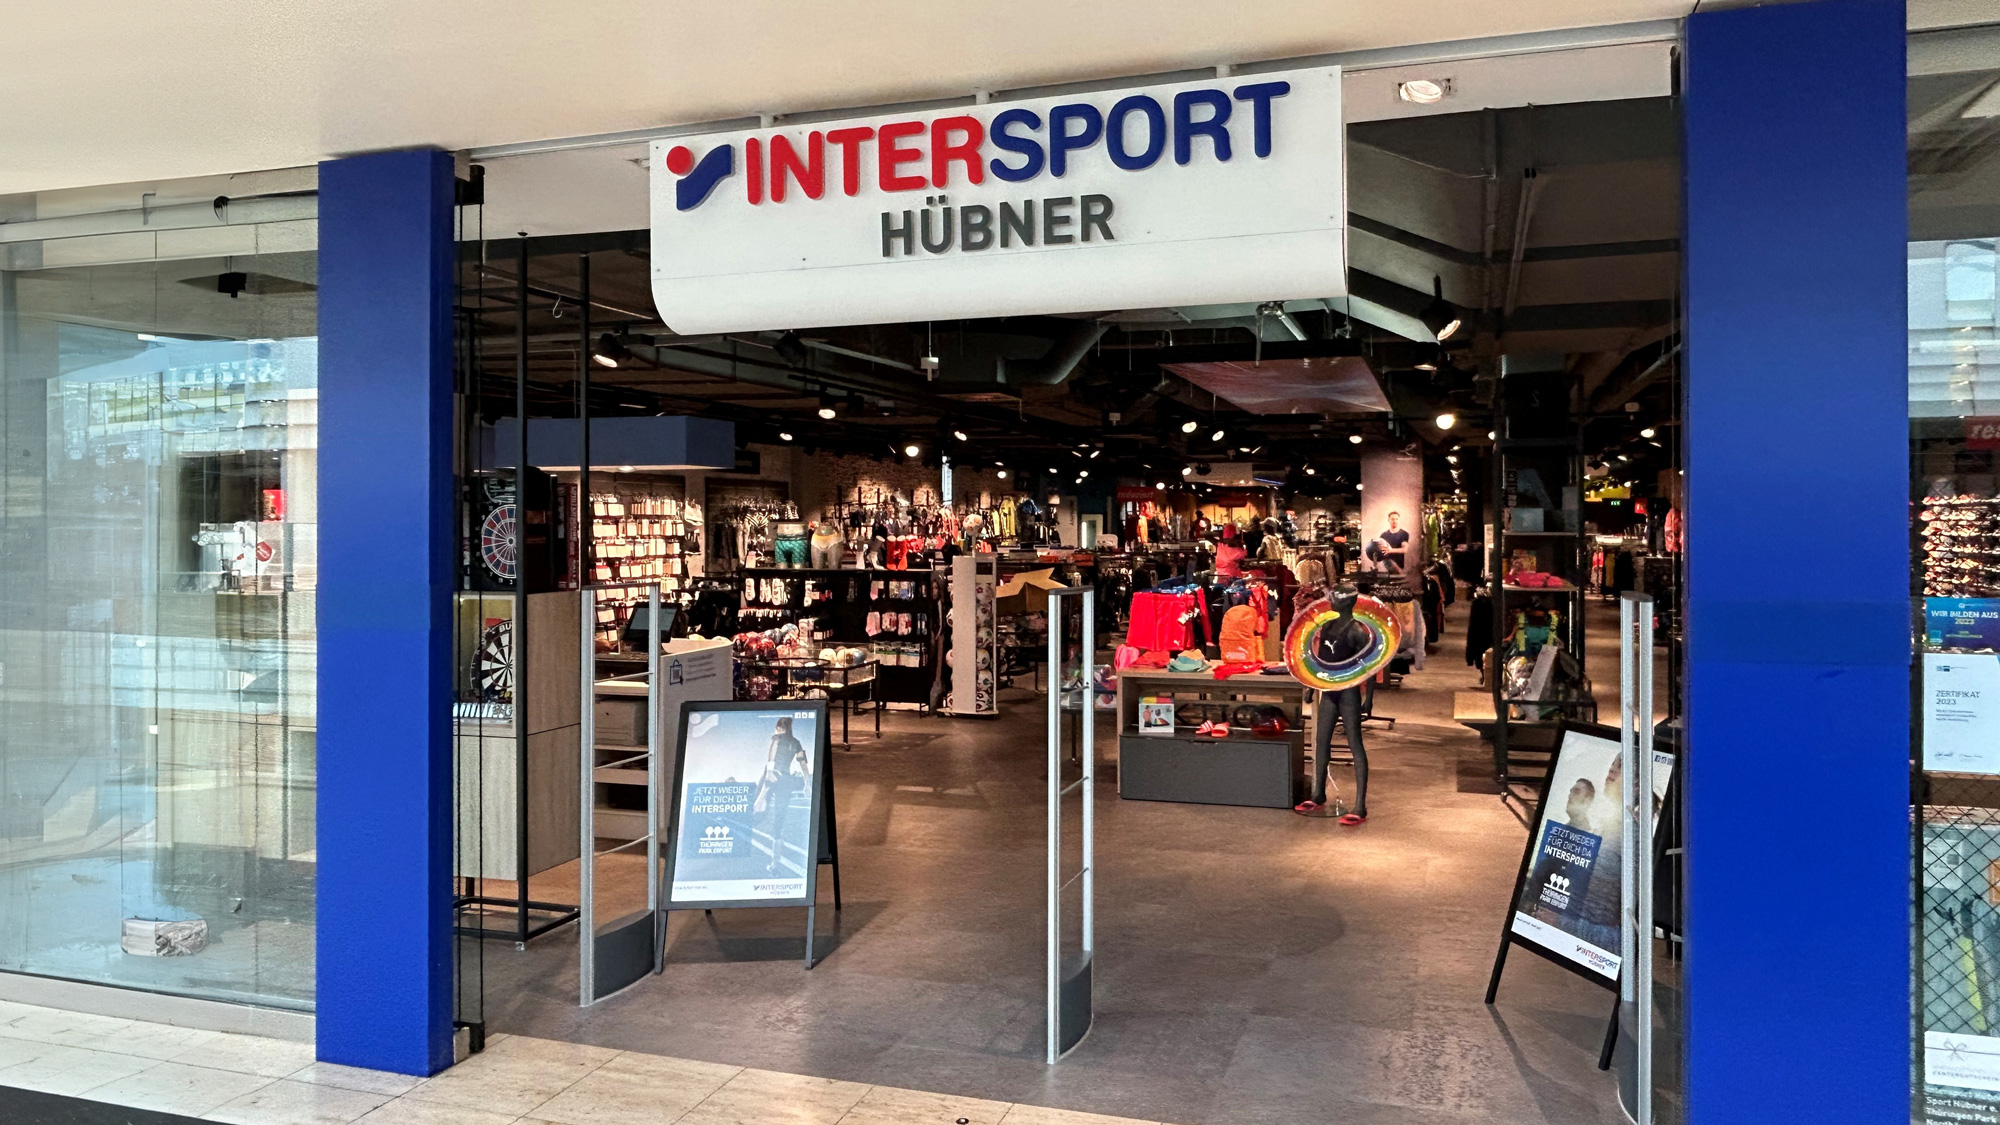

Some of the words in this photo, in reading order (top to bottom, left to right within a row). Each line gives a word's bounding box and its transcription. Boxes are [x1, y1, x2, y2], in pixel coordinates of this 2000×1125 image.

[745, 81, 1291, 207] INTERSPORT
[880, 193, 1116, 258] HÜBNER
[1935, 690, 1980, 699] ZERTIFIKAT
[1936, 698, 1957, 706] 2023
[693, 786, 717, 795] JETZT
[718, 786, 750, 794] WIEDER
[693, 795, 712, 804] FÜR
[713, 795, 734, 804] DICH
[736, 795, 748, 803] DA
[691, 804, 749, 813] INTERSPORT
[1550, 826, 1570, 838] JETZT
[1569, 831, 1596, 847] WIEDER
[1547, 835, 1563, 847] FÜR
[1562, 841, 1581, 854] DICH
[1581, 847, 1592, 858] DA
[1543, 845, 1592, 869] INTERSPORT
[1580, 947, 1619, 970] INTERSPORT
[1926, 1096, 1952, 1107] Sport
[1952, 1100, 1988, 1111] Hübner
[1925, 1107, 1973, 1120] Thüringen
[1975, 1113, 1997, 1123] Park
